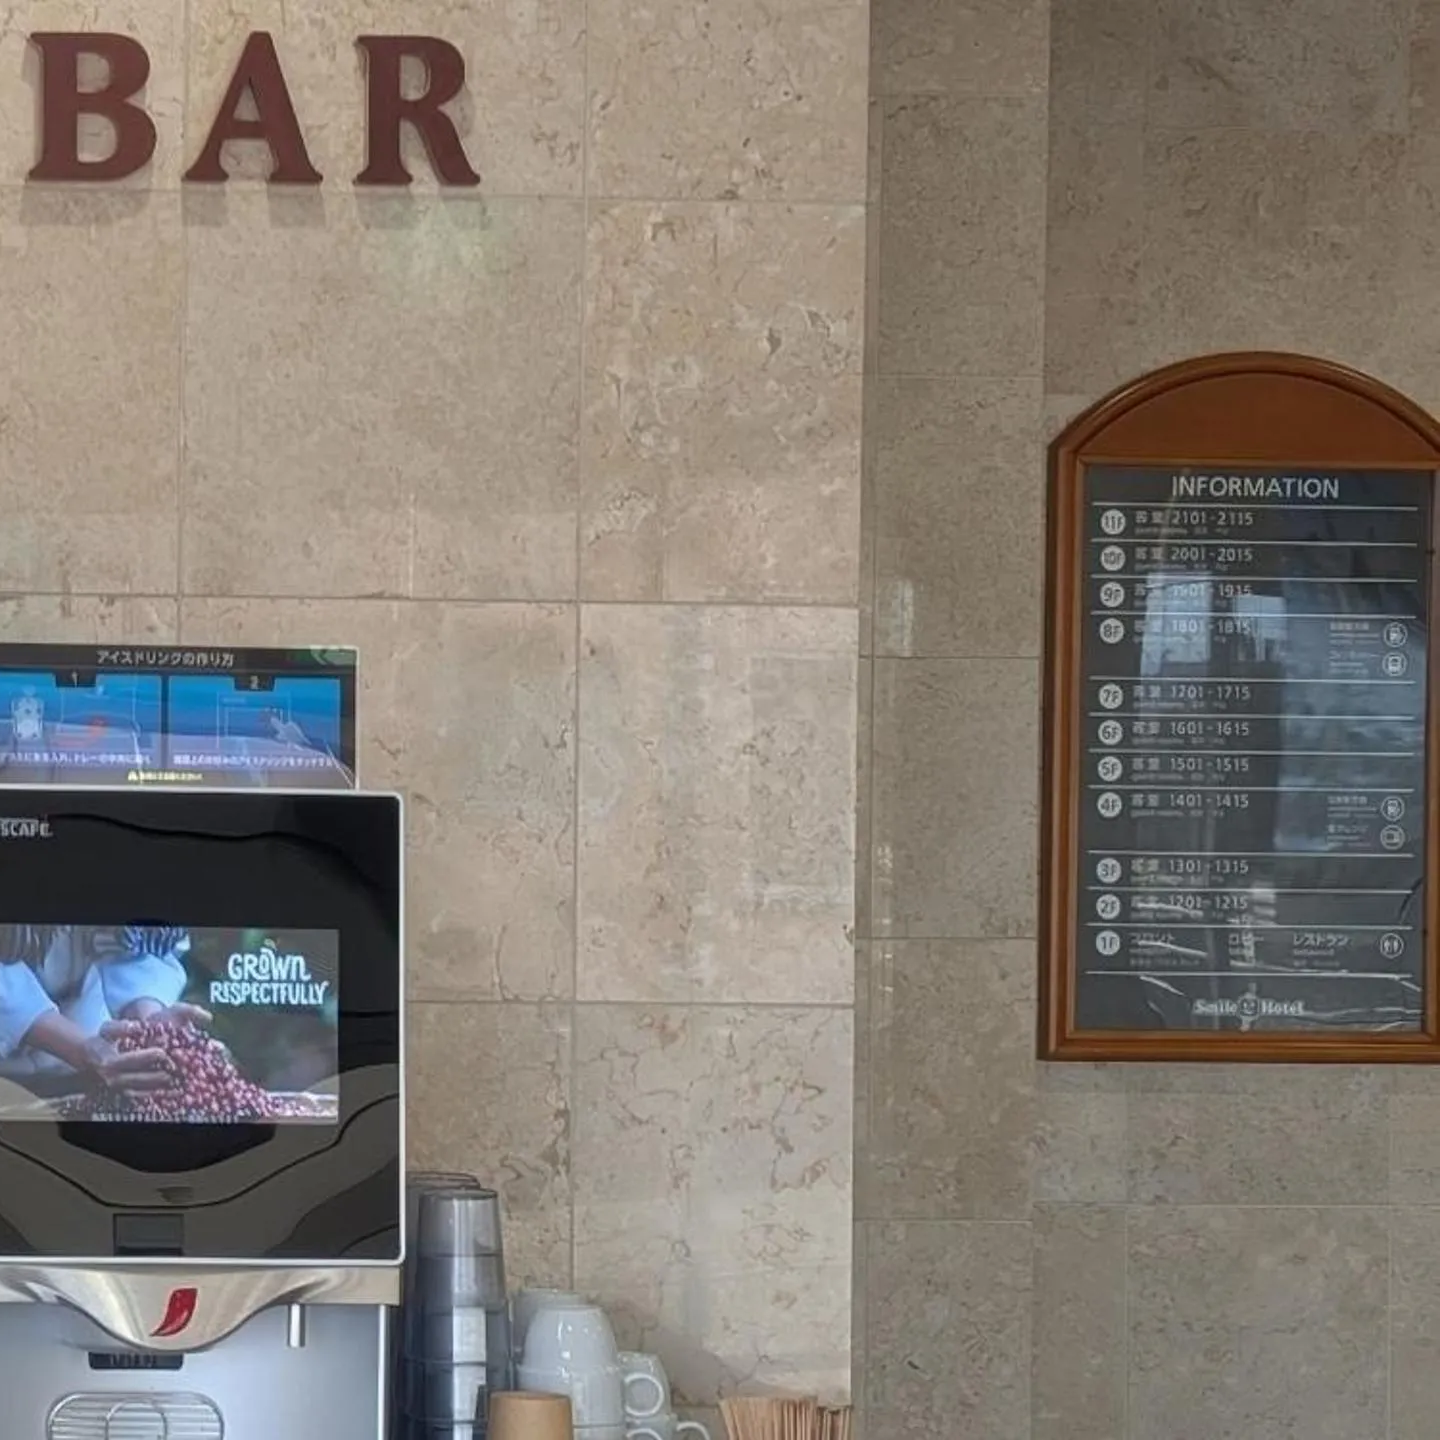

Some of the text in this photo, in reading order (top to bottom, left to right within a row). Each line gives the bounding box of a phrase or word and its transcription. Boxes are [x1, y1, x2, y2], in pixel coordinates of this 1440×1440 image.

[23, 30, 482, 188] BAR
[1171, 475, 1340, 499] INFORMATION
[1292, 932, 1351, 946] レストラン
[210, 980, 330, 1006] RESPECTFULLY
